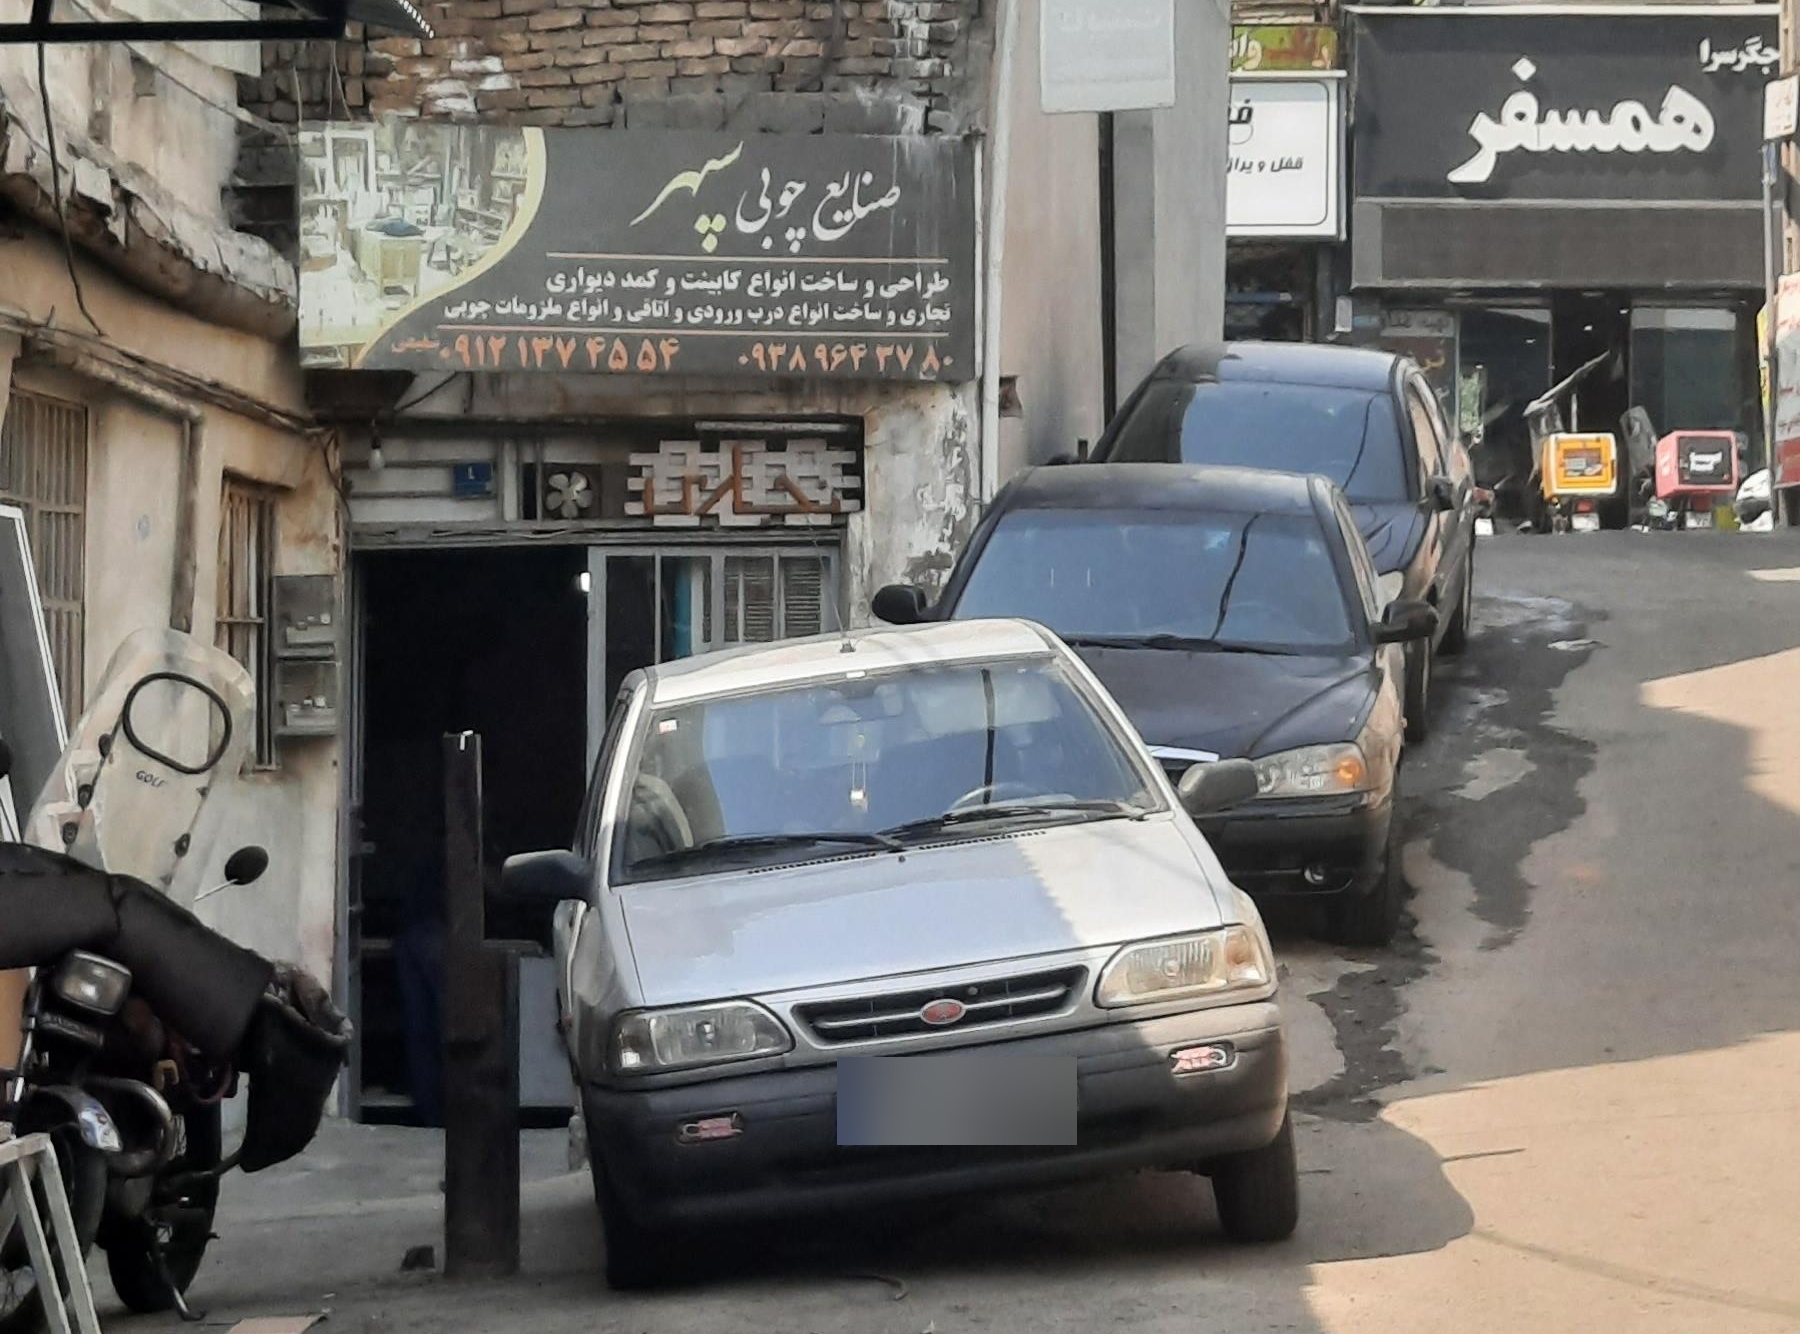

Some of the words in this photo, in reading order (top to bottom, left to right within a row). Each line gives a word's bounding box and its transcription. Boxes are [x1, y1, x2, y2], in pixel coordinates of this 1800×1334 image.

[1446, 57, 1715, 183] همسفر
[1257, 160, 1267, 173] و
[1270, 155, 1304, 173] قفل
[629, 140, 744, 254] سپهر
[811, 170, 900, 242] صنایع
[735, 167, 807, 254] چوبی
[545, 266, 616, 294] دیواری
[620, 268, 660, 289] کمد
[664, 277, 676, 295] و
[681, 269, 744, 295] کابینت
[747, 269, 796, 297] انواع
[800, 270, 859, 292] ساخت
[862, 278, 875, 299] و
[879, 270, 950, 299] طراحی
[443, 299, 492, 319] چوبی
[494, 295, 563, 320] ملزومات
[566, 297, 609, 322] انواع
[611, 305, 622, 323] و
[625, 298, 670, 323] اتاقی
[672, 307, 684, 324] و
[686, 303, 744, 325] ورودی
[747, 303, 785, 325] درب
[787, 301, 829, 325] انواع
[832, 301, 882, 321] ساخت
[885, 309, 896, 328] و
[439, 334, 507, 368] ۰۹۱۲
[517, 334, 577, 369] ۱۳۷
